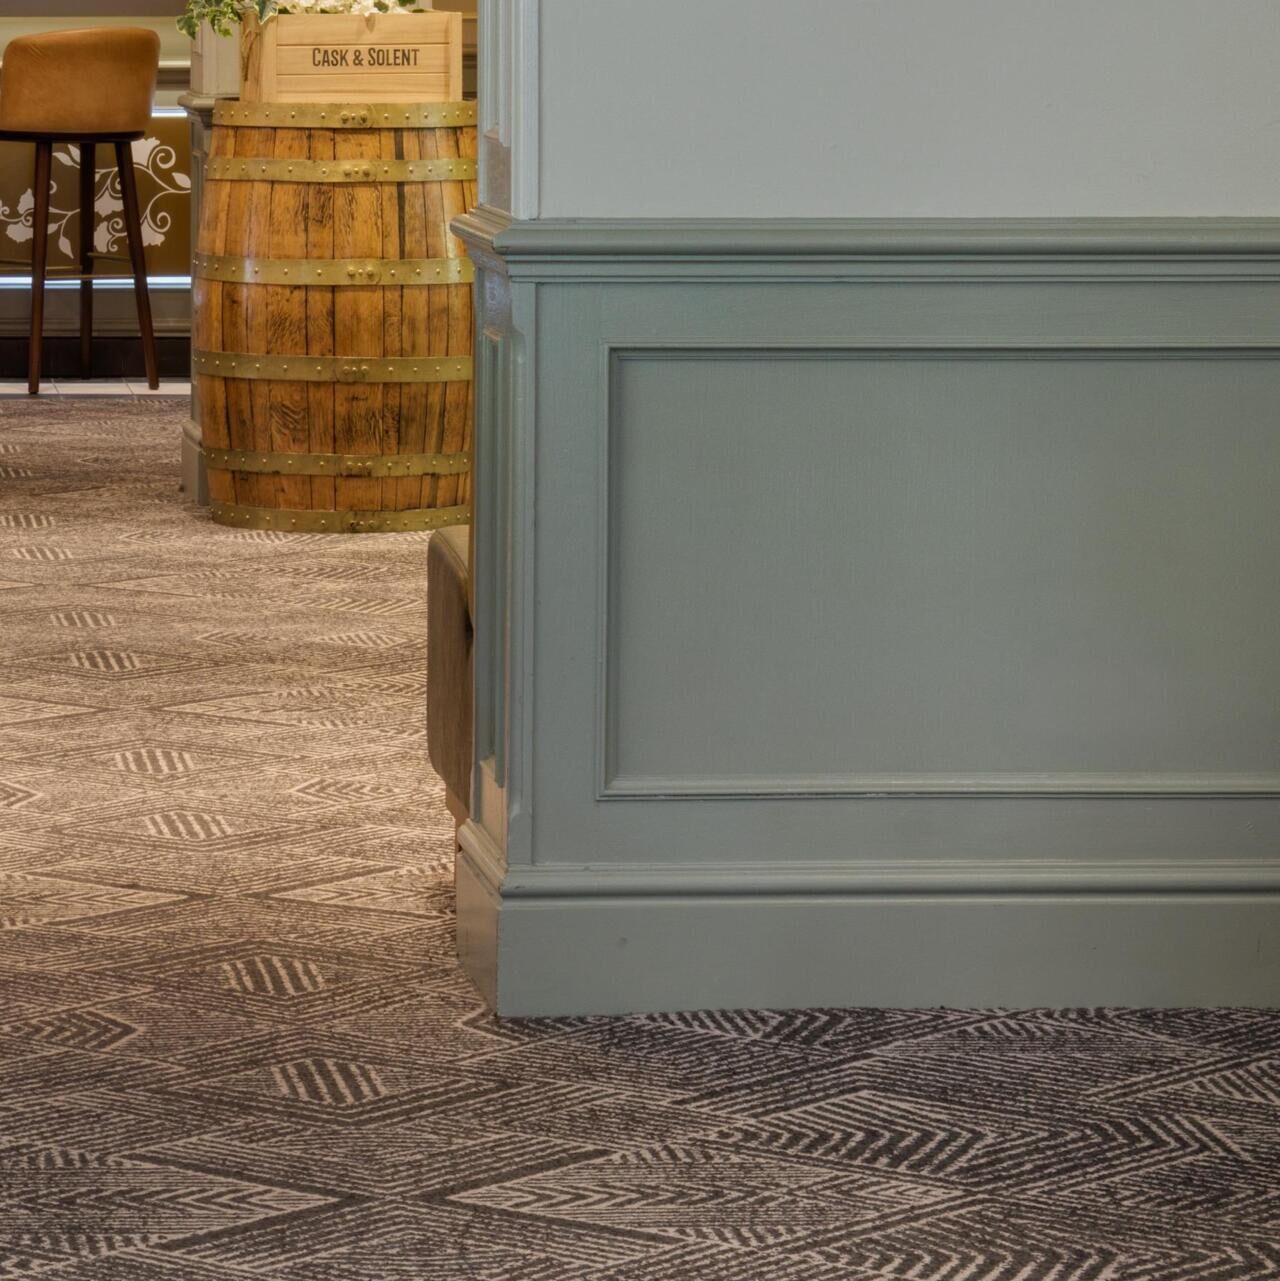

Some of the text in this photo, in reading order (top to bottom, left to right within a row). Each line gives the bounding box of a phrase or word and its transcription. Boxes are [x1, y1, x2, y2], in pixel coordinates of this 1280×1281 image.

[312, 47, 420, 67] CASK & SOLENT
